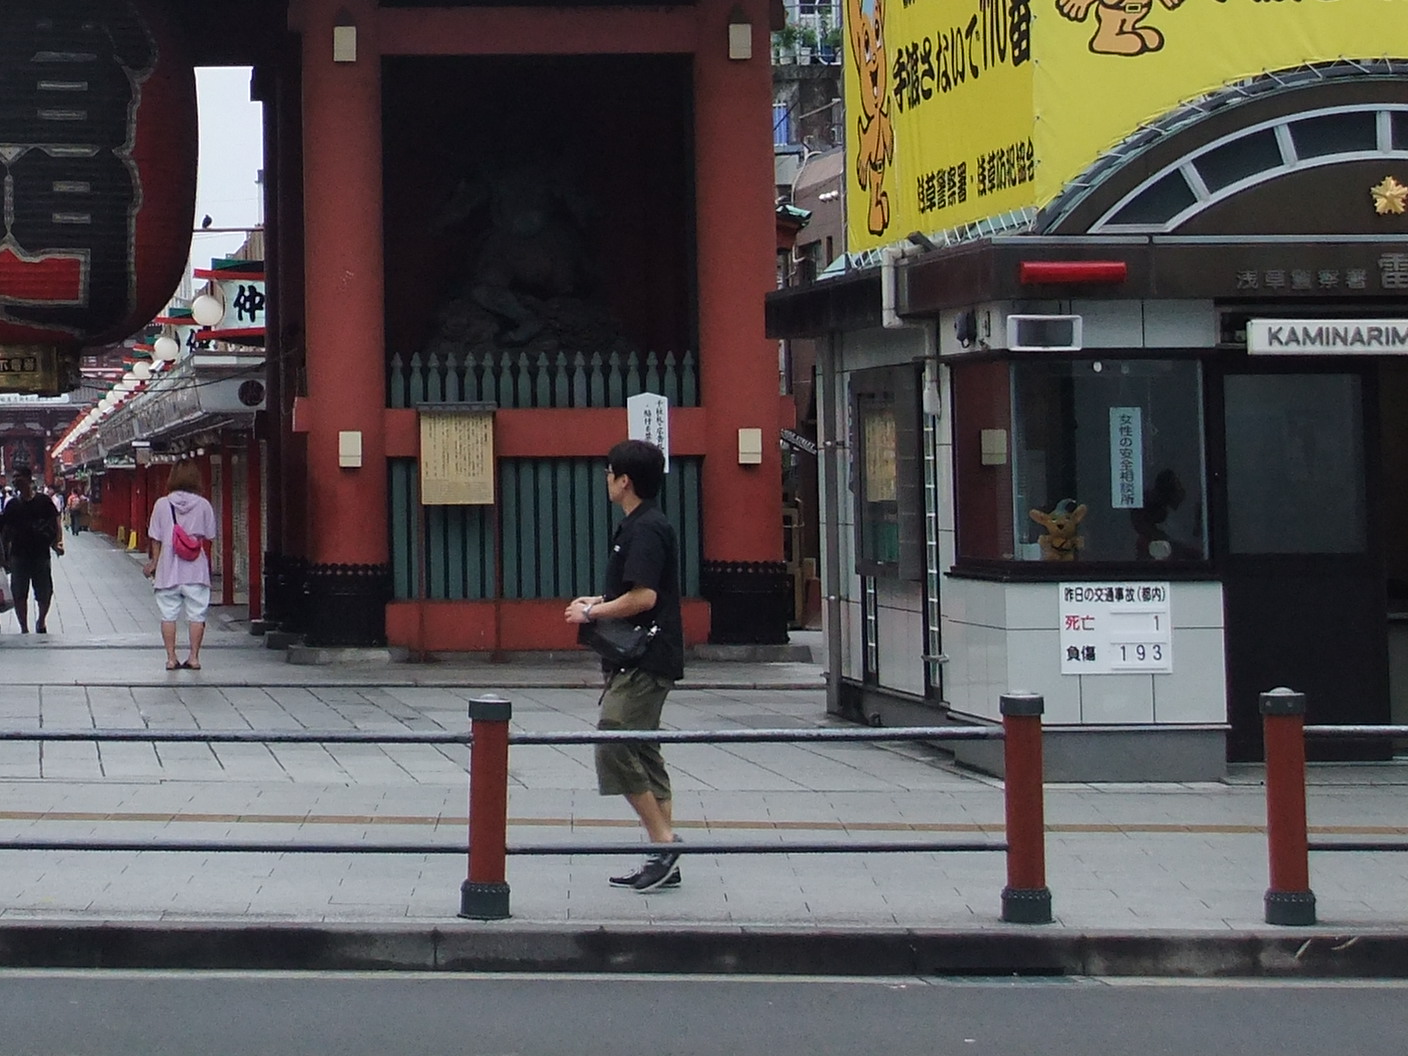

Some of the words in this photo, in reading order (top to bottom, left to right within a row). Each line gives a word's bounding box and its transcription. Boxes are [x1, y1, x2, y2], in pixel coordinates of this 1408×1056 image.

[1064, 587, 1166, 603] 昨日の交通事故(都内)
[1065, 615, 1095, 631] 死亡
[1154, 615, 1160, 631] 1
[1066, 645, 1096, 662] 負傷
